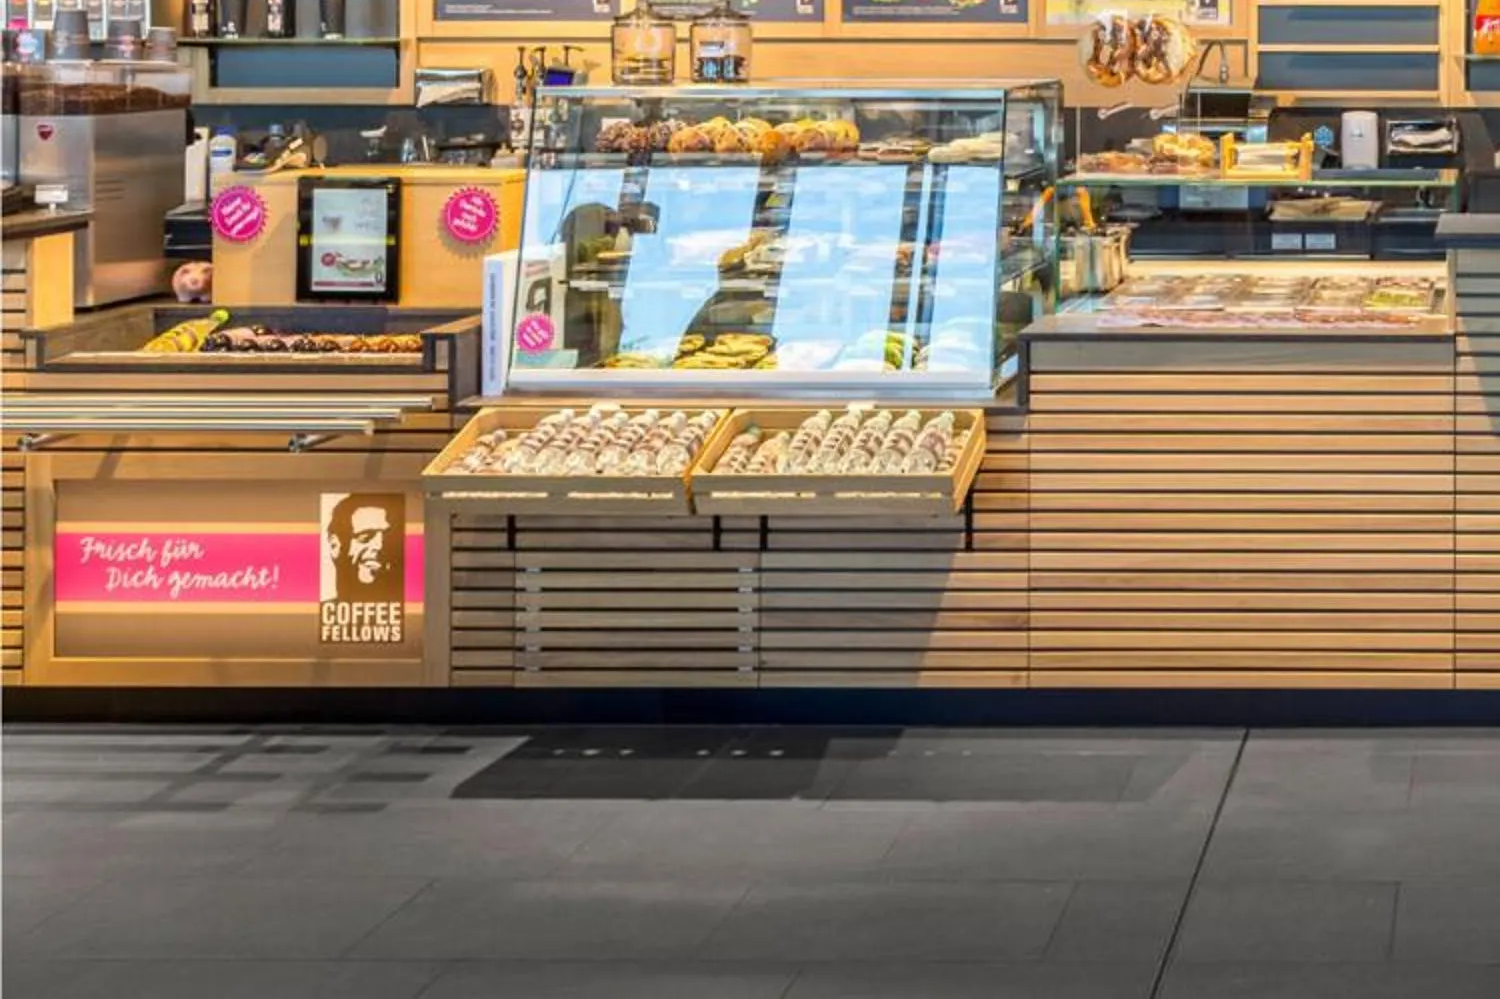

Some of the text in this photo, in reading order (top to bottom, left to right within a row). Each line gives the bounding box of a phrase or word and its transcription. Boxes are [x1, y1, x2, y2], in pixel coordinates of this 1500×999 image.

[79, 537, 204, 563] Frisch für
[106, 564, 280, 599] Dich gemacht!
[321, 602, 402, 627] COFFEE
[321, 625, 402, 642] FELLOWS
